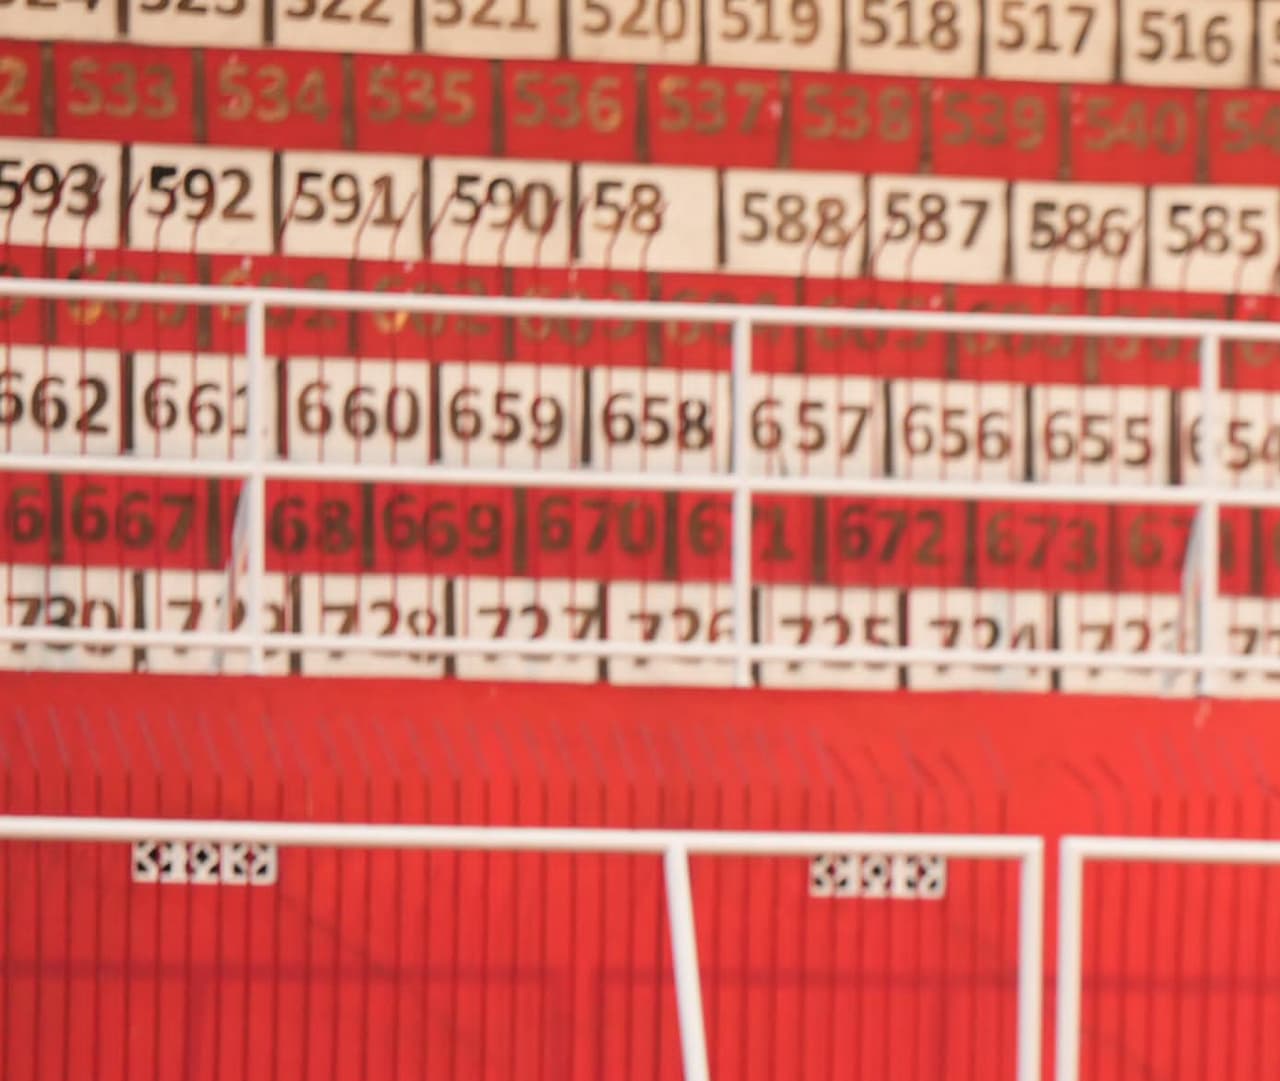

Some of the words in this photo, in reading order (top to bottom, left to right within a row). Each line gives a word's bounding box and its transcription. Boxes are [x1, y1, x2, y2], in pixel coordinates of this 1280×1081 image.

[720, 0, 822, 44] 519
[859, 0, 960, 51] 518
[999, 0, 1095, 54] 517
[1137, 10, 1231, 62] 516
[66, 57, 178, 118] 533
[216, 60, 331, 124] 534
[365, 62, 478, 126] 535
[512, 71, 624, 132] 536
[656, 76, 773, 136] 537
[803, 84, 912, 140] 538
[940, 92, 1046, 150] 539
[1081, 98, 1189, 155] 540
[0, 158, 100, 218] 593
[148, 163, 254, 222] 592
[292, 170, 400, 229] 591
[451, 175, 557, 235] 590
[739, 192, 847, 248] 588
[885, 192, 990, 250] 587
[1028, 200, 1131, 258] 586
[1167, 203, 1266, 260] 585
[299, 380, 420, 441] 660
[447, 382, 566, 450] 659
[602, 392, 713, 452] 658
[751, 396, 873, 458] 657
[904, 404, 1013, 462] 656
[1042, 409, 1153, 466] 655
[70, 484, 197, 550] 667
[382, 496, 501, 559] 669
[538, 497, 656, 557] 670
[838, 505, 947, 566] 672
[984, 511, 1100, 573] 673
